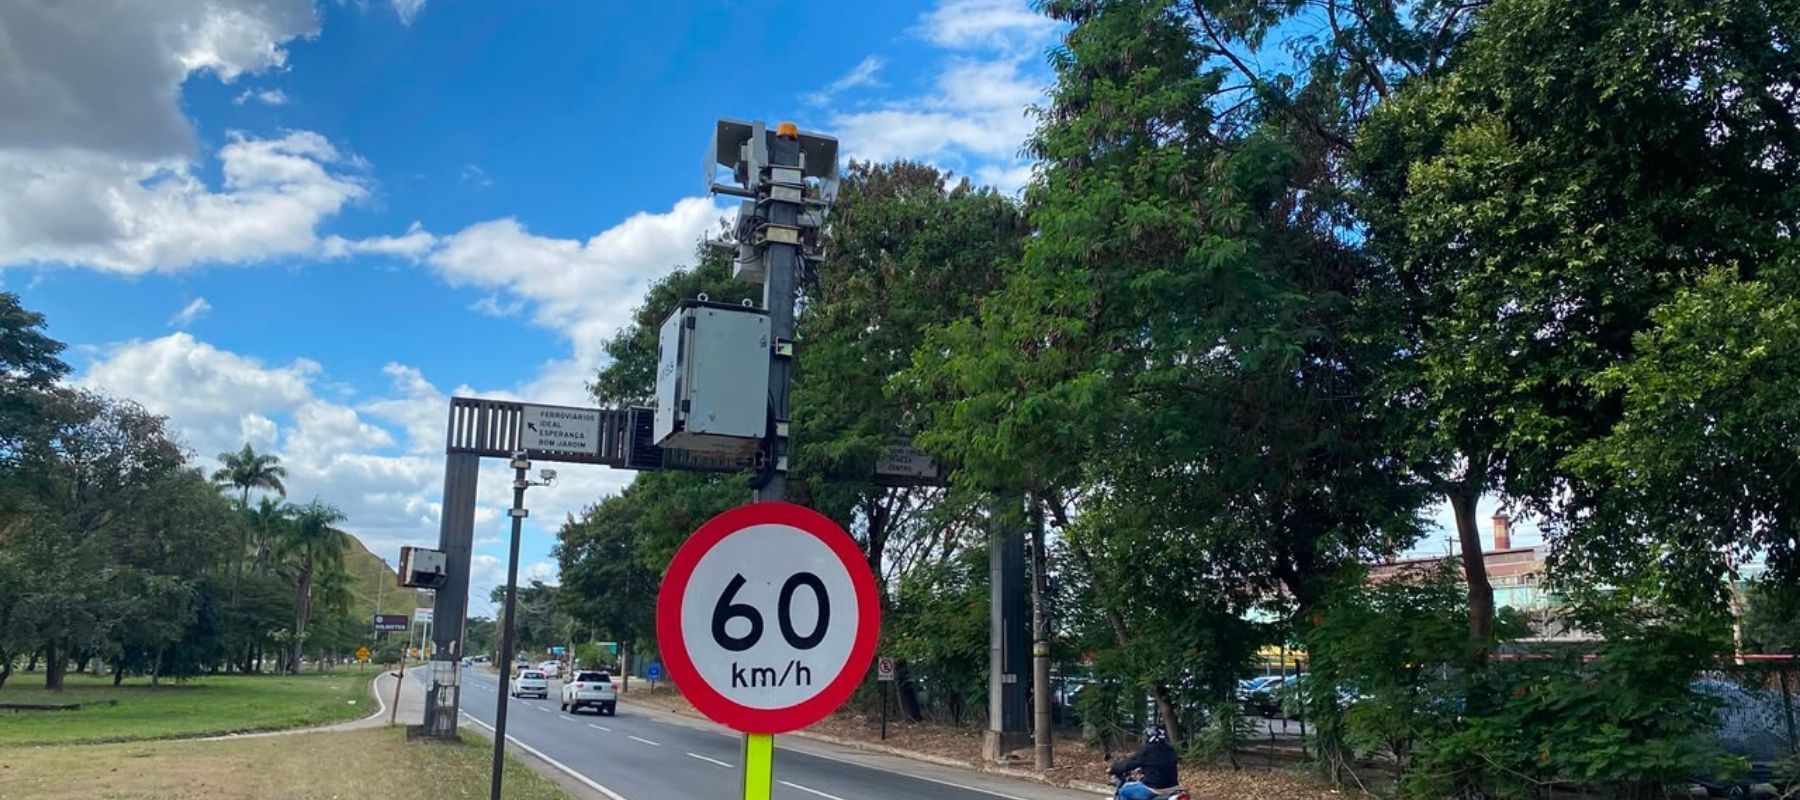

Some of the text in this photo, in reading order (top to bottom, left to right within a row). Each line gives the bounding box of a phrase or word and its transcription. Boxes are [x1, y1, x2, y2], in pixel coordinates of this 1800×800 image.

[539, 420, 561, 428] IDEAL
[557, 440, 586, 448] JARDIM
[711, 571, 831, 652] 60
[731, 660, 812, 688] km/h
